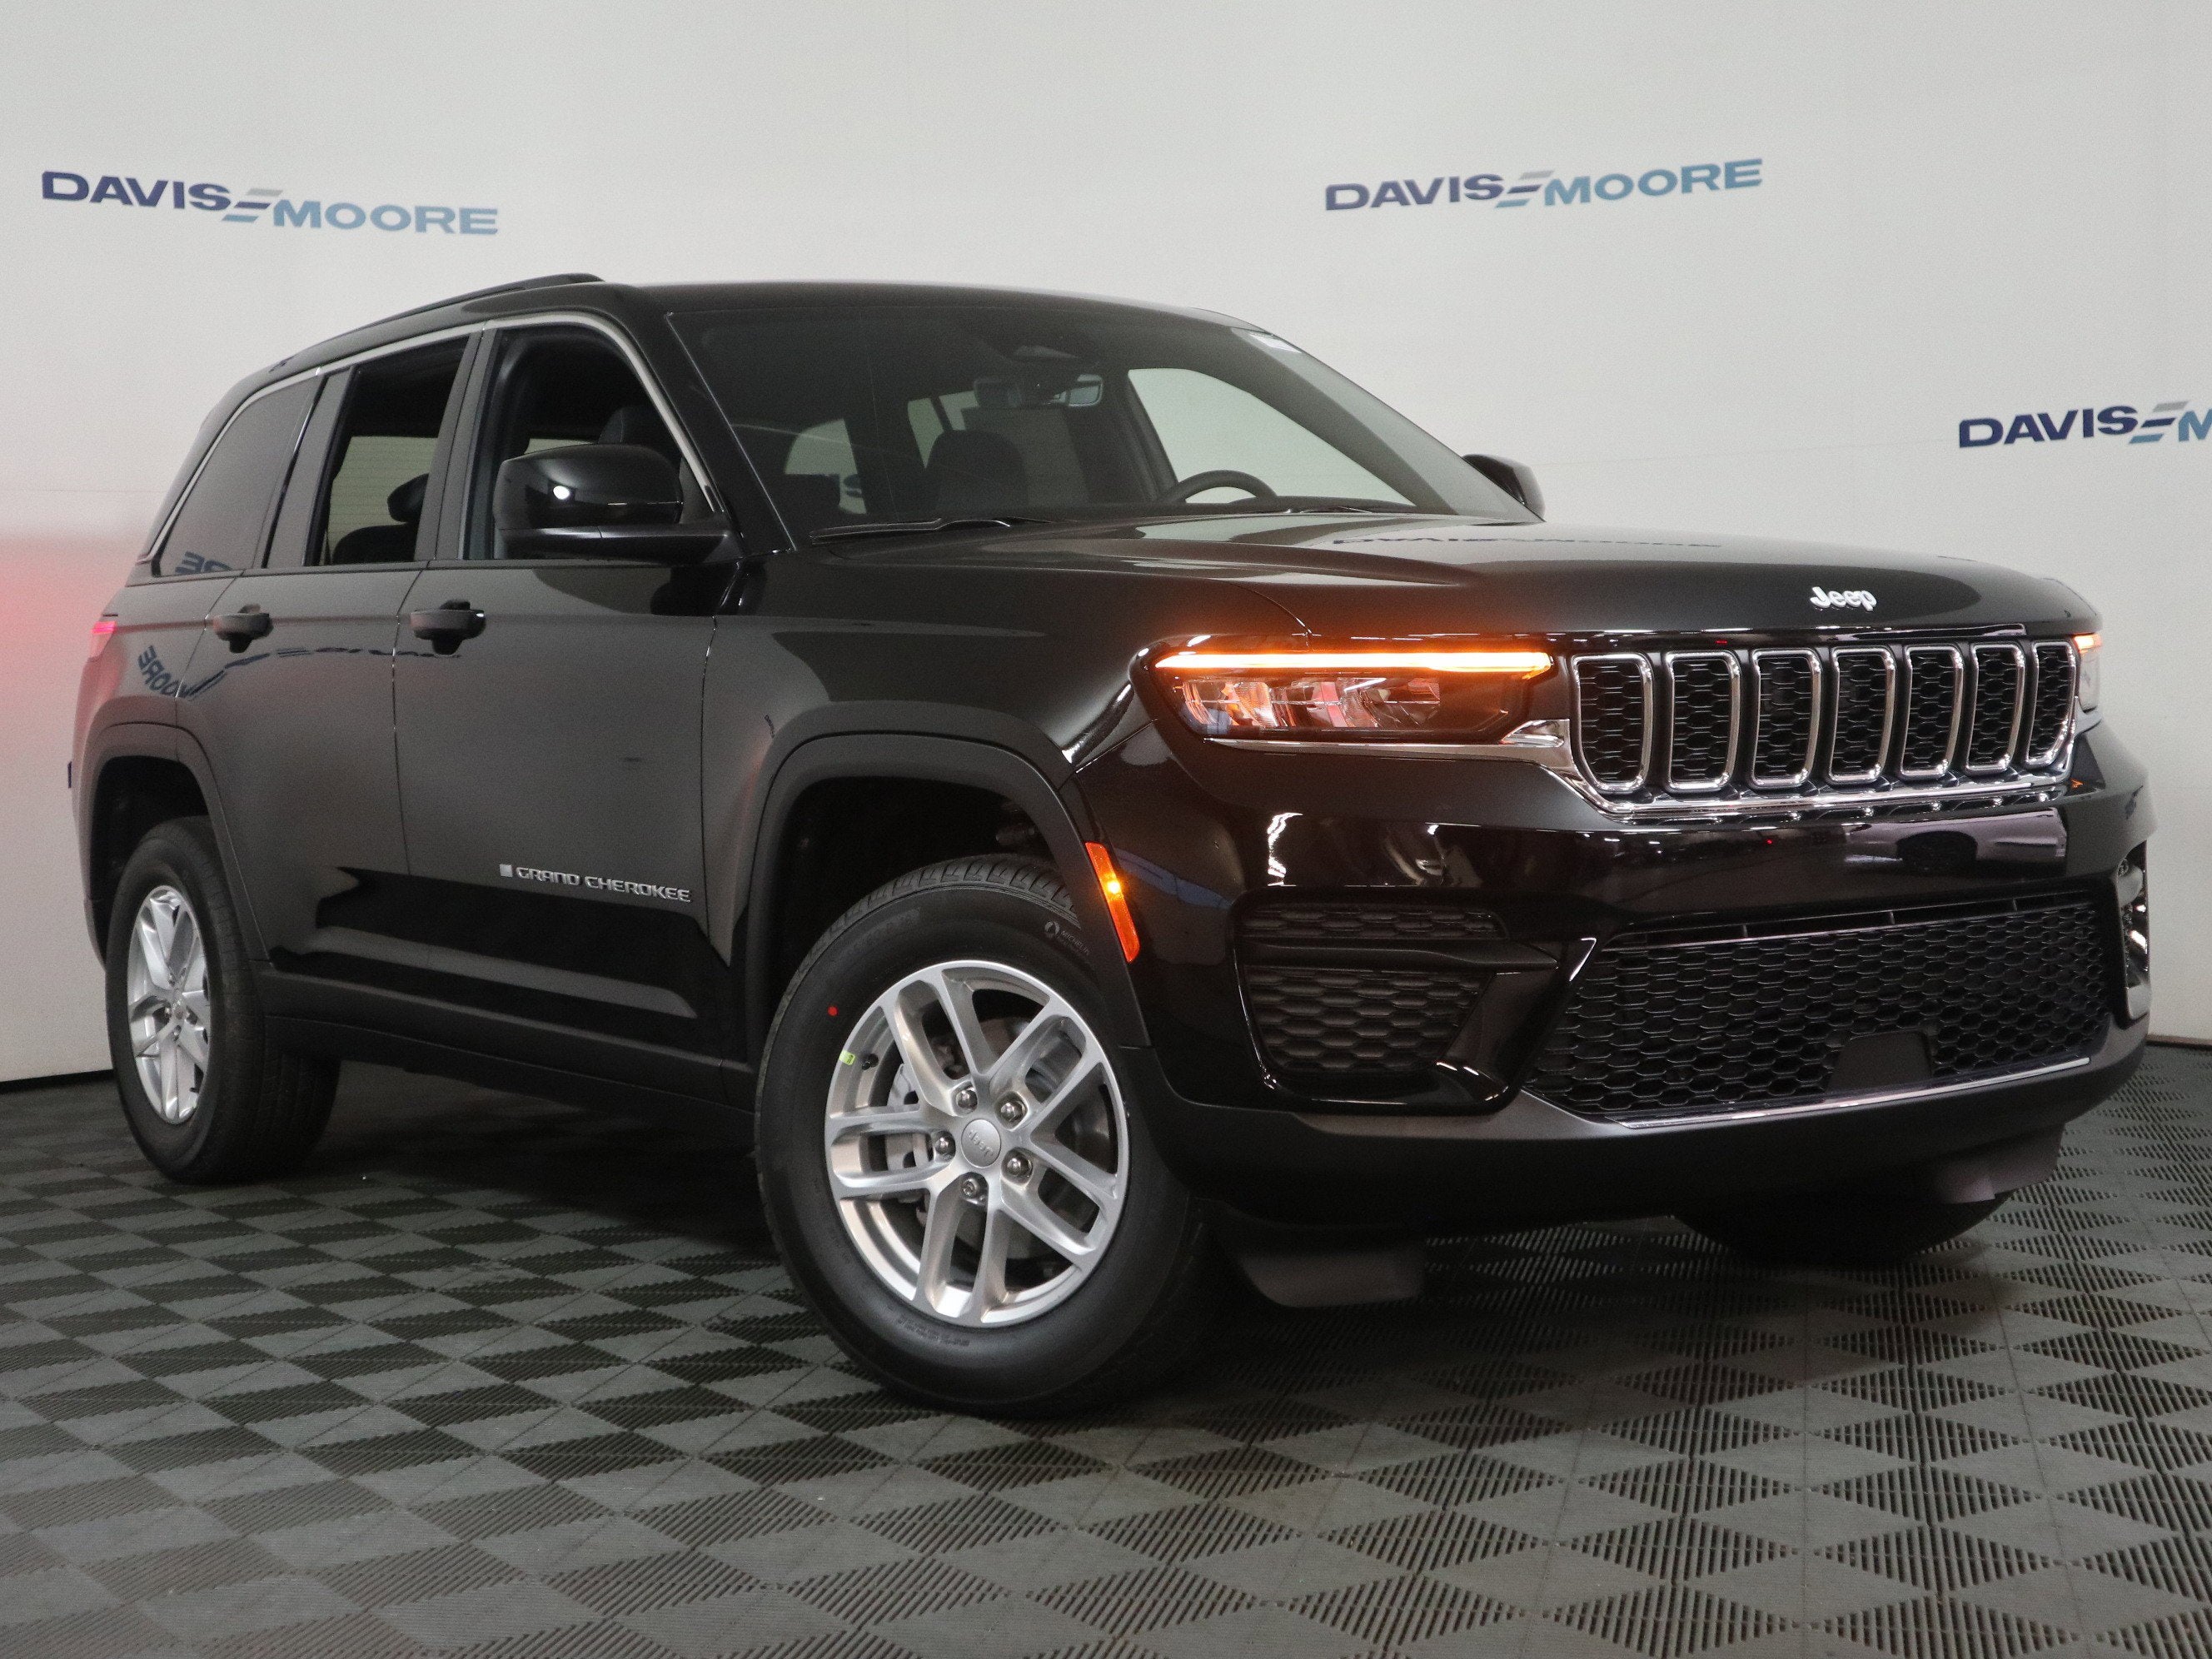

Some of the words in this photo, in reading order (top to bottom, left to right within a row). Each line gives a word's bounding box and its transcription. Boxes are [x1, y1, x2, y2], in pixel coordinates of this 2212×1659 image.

[41, 170, 232, 212] DAVIS
[272, 199, 498, 235] MOORE
[1325, 173, 1504, 211] DAVIS
[1544, 158, 1762, 206] MOORE
[1959, 406, 2139, 448] DAVIS
[1810, 586, 1877, 611] Jeep
[516, 867, 580, 886] GRAND
[584, 875, 691, 903] CHEROKEE
